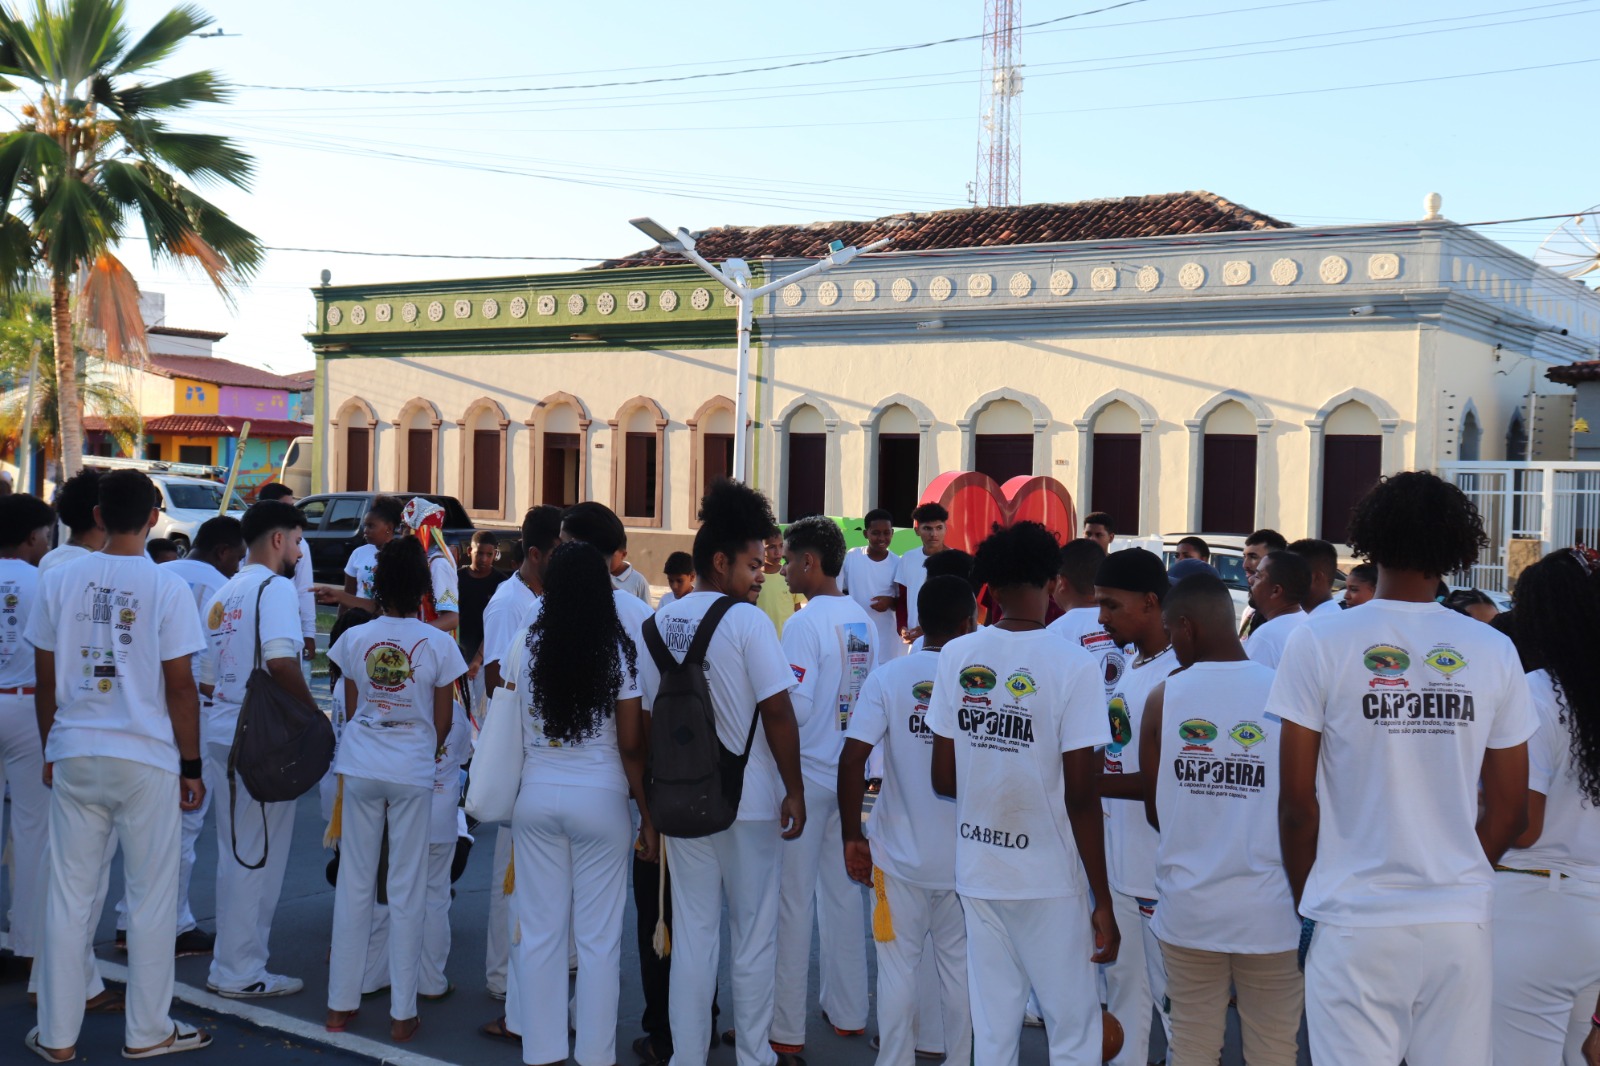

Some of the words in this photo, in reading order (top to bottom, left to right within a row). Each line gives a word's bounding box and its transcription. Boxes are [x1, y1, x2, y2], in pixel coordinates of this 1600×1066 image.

[1362, 693, 1475, 722] CAPOEIRA
[958, 708, 1034, 742] CPOEIRA
[1174, 758, 1265, 788] CAPOEIRA
[960, 822, 1029, 850] CABELO
